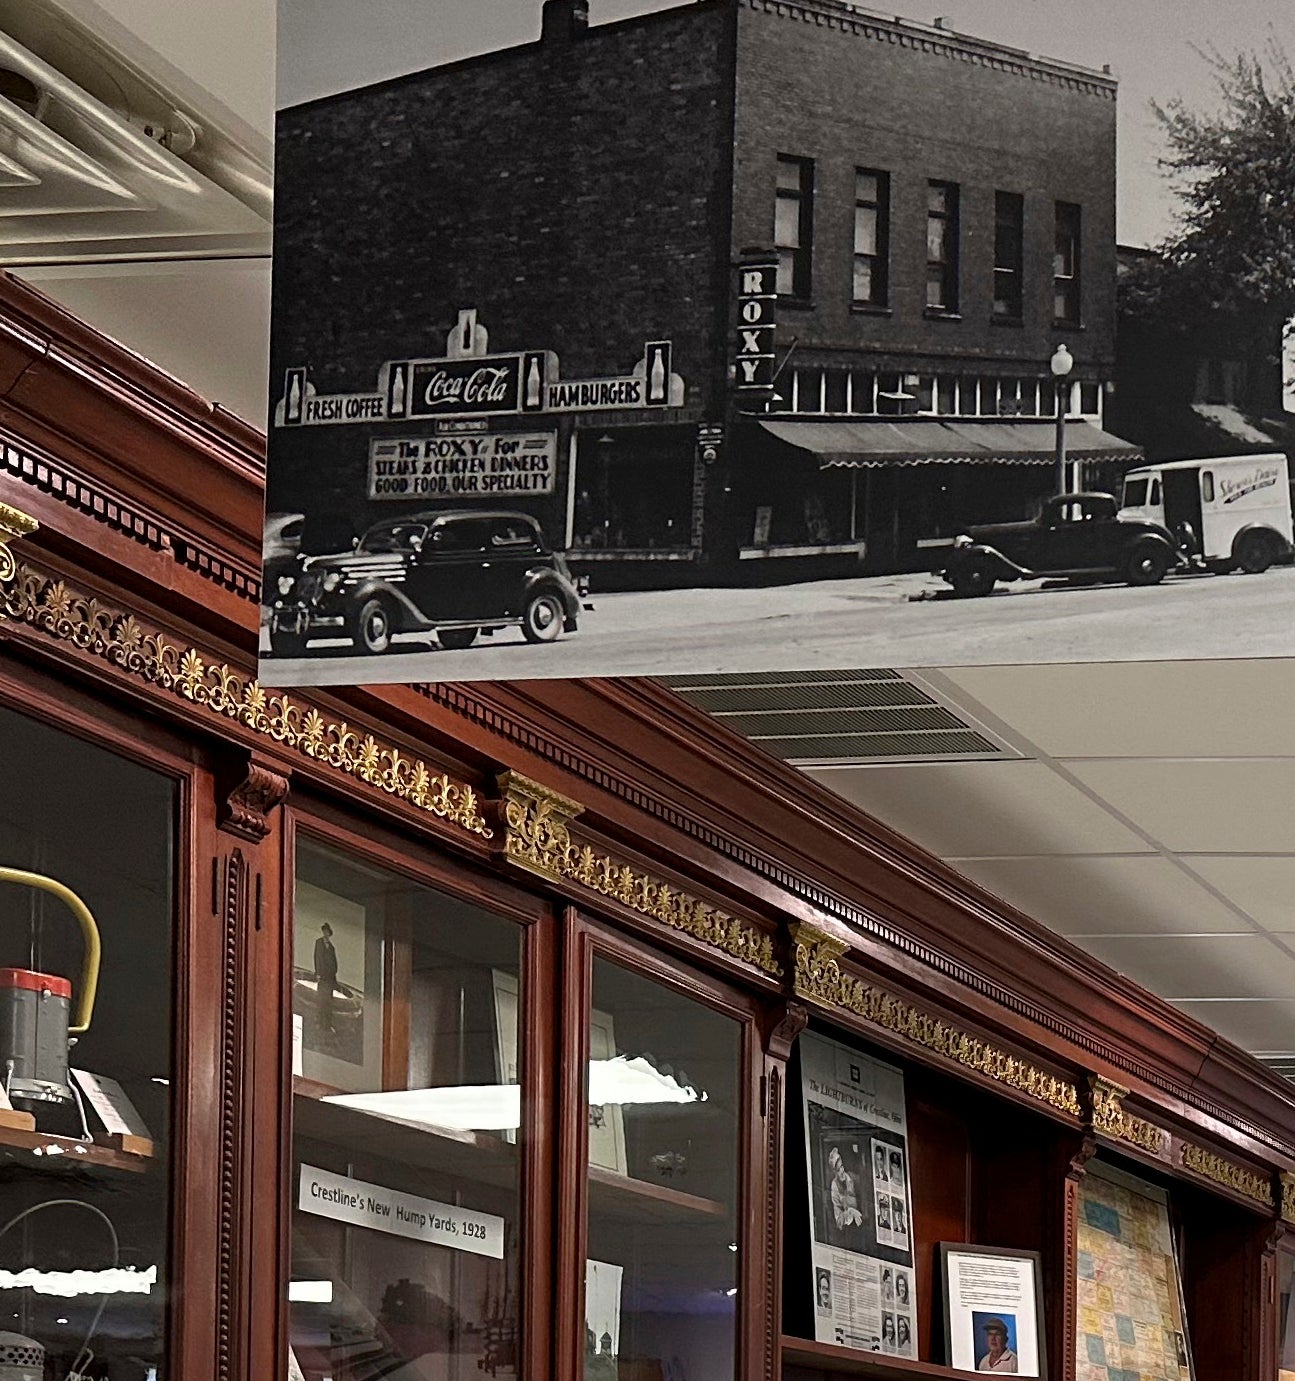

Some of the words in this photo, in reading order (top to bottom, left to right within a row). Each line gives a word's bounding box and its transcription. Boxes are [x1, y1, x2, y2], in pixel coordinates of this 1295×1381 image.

[741, 270, 763, 383] ROXY
[424, 366, 511, 405] Coca-Cola
[548, 381, 641, 408] HAMBURGERS
[306, 399, 343, 421] FRESH
[345, 396, 384, 420] COFFEE
[399, 441, 419, 458] The
[494, 437, 520, 455] For
[375, 459, 418, 476] STEAKS
[434, 457, 486, 475] CHICKEN
[490, 455, 549, 473] DINNERS
[375, 477, 409, 494] GOOD
[452, 474, 479, 492] OUR
[481, 473, 551, 491] SPECIALTY
[310, 1181, 365, 1211] Crestline's
[367, 1197, 391, 1217] New
[396, 1205, 427, 1229] Hump
[428, 1214, 460, 1236] Yards,
[462, 1221, 486, 1240] 1928
